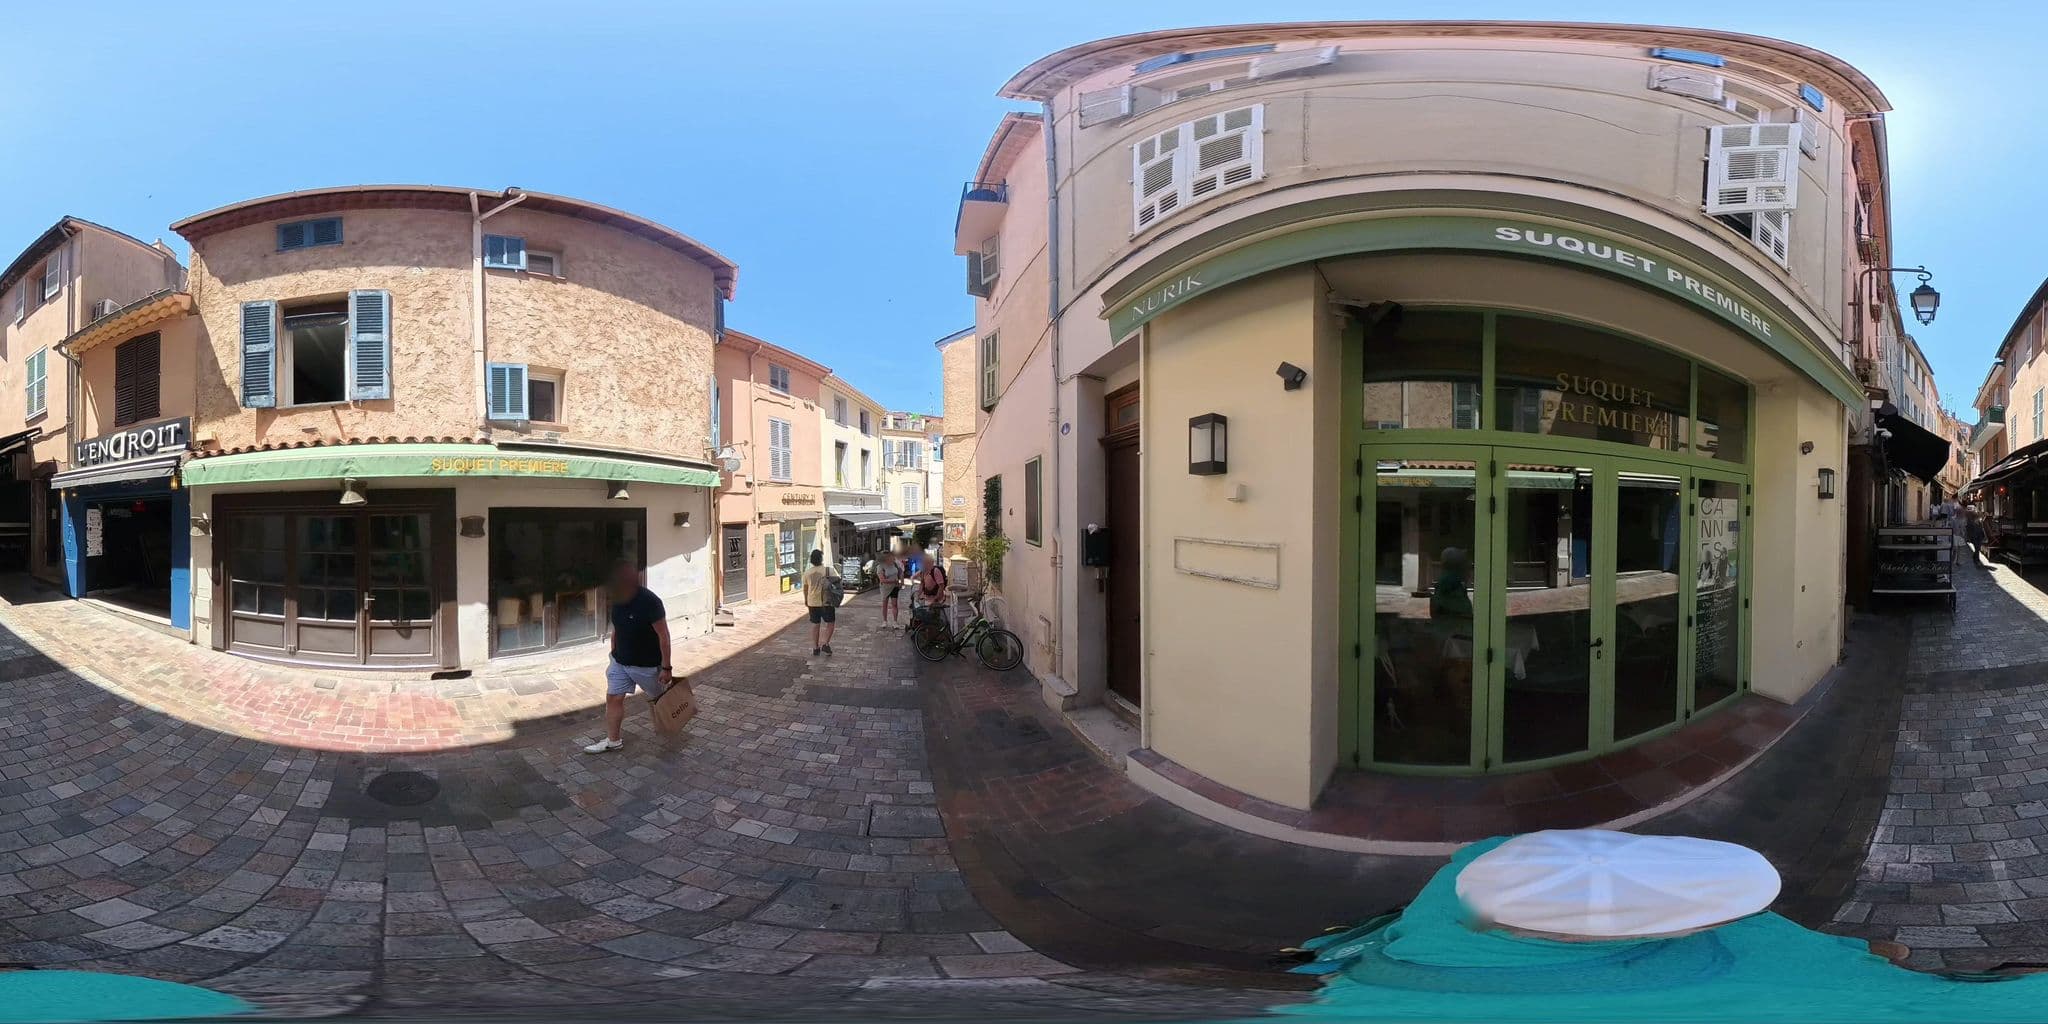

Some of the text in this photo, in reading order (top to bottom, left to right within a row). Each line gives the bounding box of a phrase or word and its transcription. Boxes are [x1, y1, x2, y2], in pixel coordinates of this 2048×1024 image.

[1131, 272, 1202, 320] NURIK
[1495, 227, 1772, 337] SUQUET PREMIERE
[1555, 372, 1654, 409] SUQUET
[1542, 400, 1668, 437] PREMIERE
[77, 422, 180, 462] L'ENDROIT
[432, 458, 569, 473] SUQUET PREMIERE
